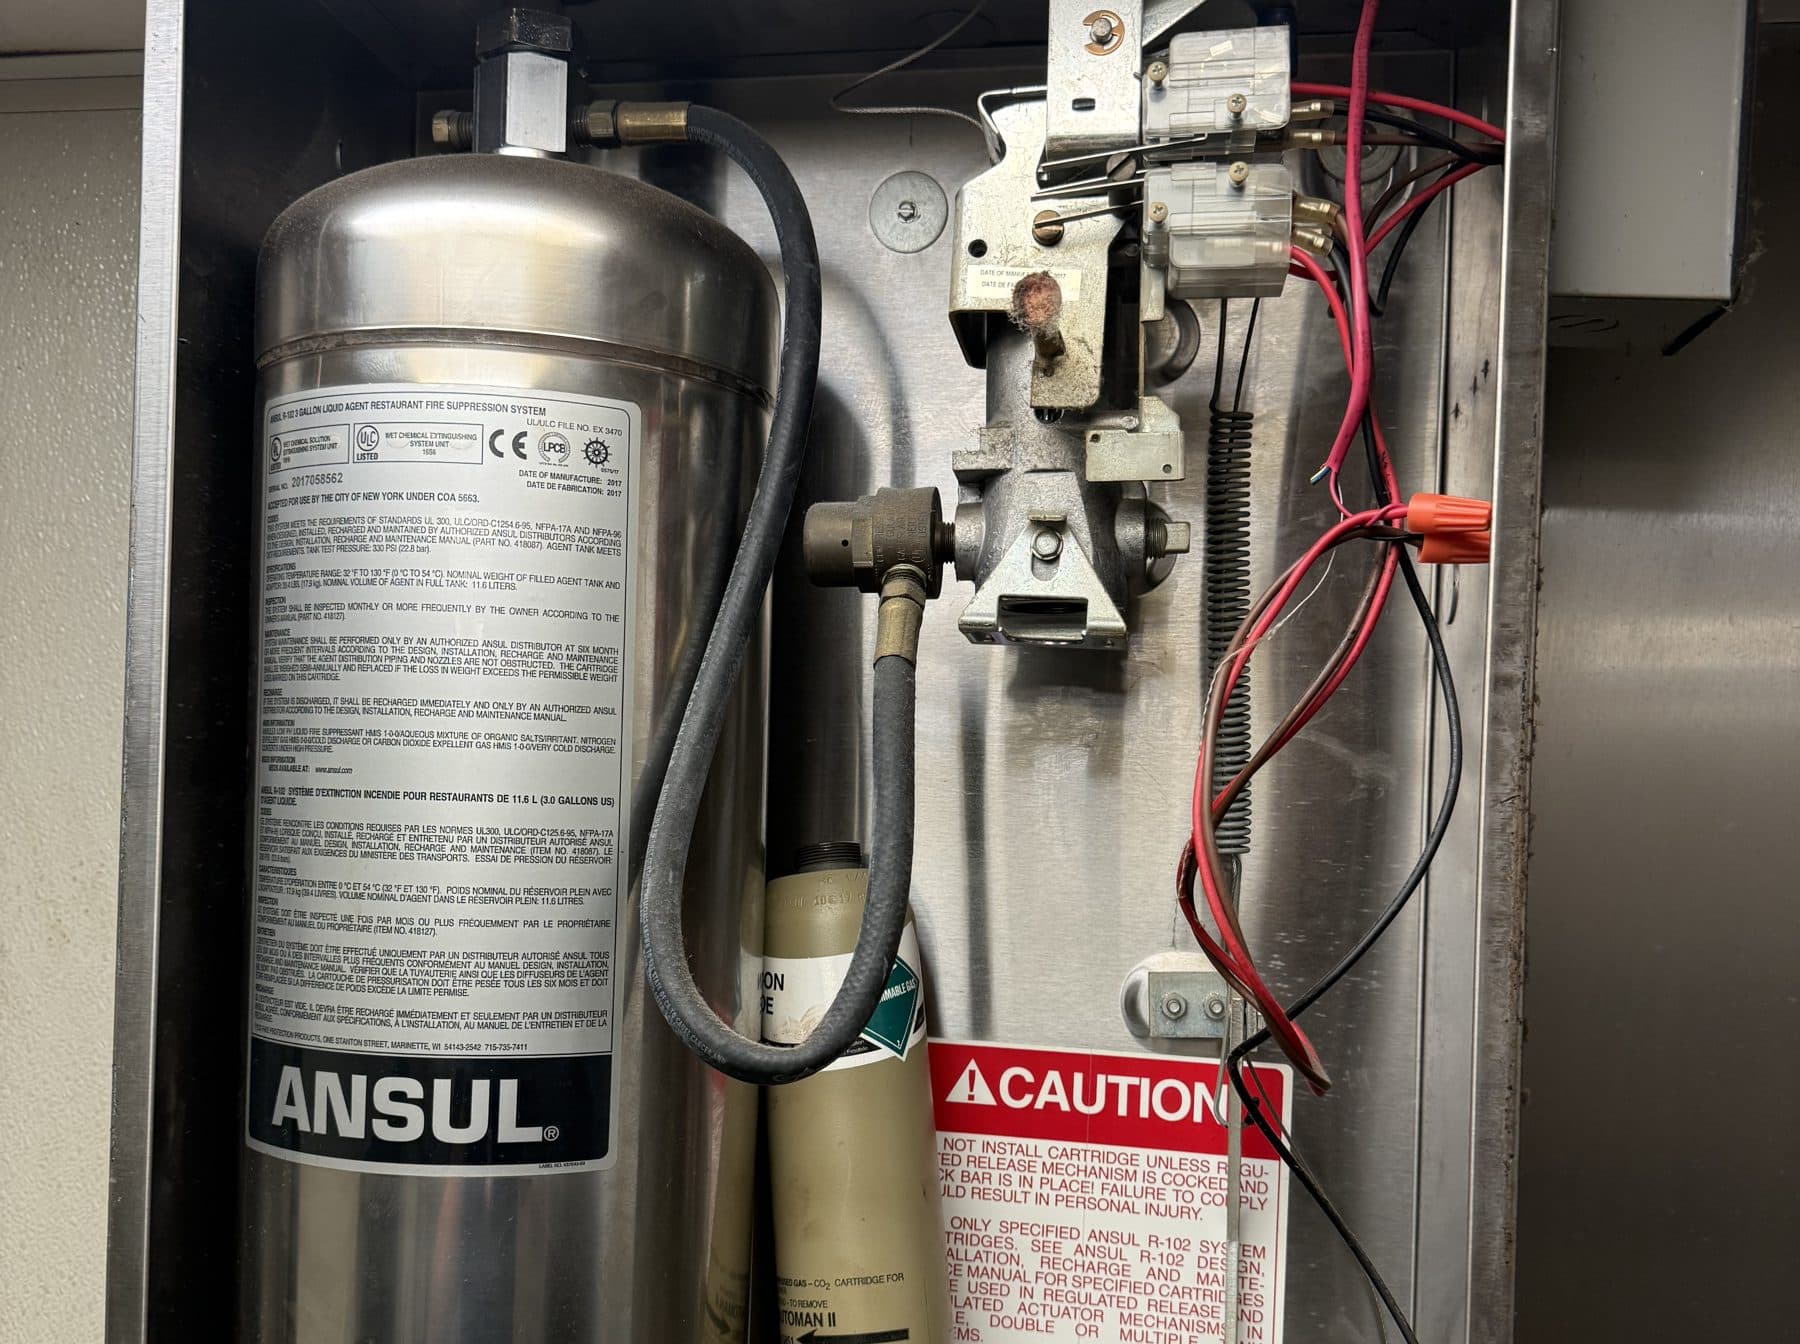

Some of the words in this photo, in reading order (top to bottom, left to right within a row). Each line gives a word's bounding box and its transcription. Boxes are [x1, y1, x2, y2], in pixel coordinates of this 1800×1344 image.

[294, 409, 299, 418] 3
[299, 406, 322, 417] GALLON
[322, 403, 343, 414] LIQUID
[345, 402, 369, 412] AGENT
[370, 401, 423, 411] RESTAURANT
[425, 401, 444, 410] FIRE
[447, 402, 508, 413] SUPPRESSION
[511, 406, 546, 416] SYSTEM
[430, 432, 477, 441] EXTINGUISHING
[527, 418, 555, 428] UL/ULC
[558, 422, 574, 430] FILE
[593, 426, 603, 434] EX
[605, 427, 622, 436] 3470
[292, 472, 343, 488] 2017058562
[519, 469, 538, 478] DATE
[539, 470, 548, 478] OF
[550, 472, 602, 485] MANUFACTURE:
[607, 478, 622, 487] 2017
[289, 497, 299, 506] FOR
[300, 495, 310, 505] USE
[311, 494, 320, 504] BY
[321, 494, 333, 504] THE
[335, 493, 349, 502] CITY
[351, 492, 361, 502] OF
[362, 492, 381, 501] NEW
[382, 492, 404, 501] YORK
[406, 492, 435, 501] UNDER
[436, 492, 456, 502] COA
[458, 493, 480, 503] 5663.
[527, 481, 544, 490] DATE
[547, 482, 557, 490] DE
[558, 483, 604, 495] FABRICATION:
[607, 488, 622, 497] 2017
[447, 570, 482, 579] NOMINAL
[483, 572, 515, 582] WEIGHT
[516, 573, 527, 582] OF
[529, 574, 555, 584] FILLED
[557, 575, 583, 586] AGENT
[584, 578, 604, 588] TANK
[605, 581, 621, 589] AND
[315, 788, 362, 799] D'EXTINCTION
[364, 790, 401, 800] INCENDIE
[403, 791, 427, 801] POUR
[430, 792, 494, 802] RESTAURANTS
[497, 794, 509, 804] DE
[512, 795, 529, 804] 11.6
[532, 795, 537, 804] L
[540, 795, 555, 807] (3.0
[558, 796, 598, 805] GALLONS
[601, 797, 615, 808] US)
[336, 1037, 362, 1047] STANTON
[391, 1041, 430, 1051] MARINETTE,
[444, 1043, 482, 1051] 54143-2542
[484, 1043, 527, 1051] 715-735-7411
[999, 1066, 1228, 1124] CAUTION
[944, 1138, 976, 1153] NOT
[982, 1141, 1042, 1158] INSTALL
[1048, 1146, 1140, 1166] CARTRIDGE
[1146, 1154, 1210, 1173] UNLESS
[1217, 1161, 1269, 1178] RGU-
[967, 1155, 1037, 1173] RELEASE
[1042, 1162, 1137, 1182] MECHANISM
[1142, 1171, 1157, 1184] IS
[1162, 1173, 1228, 1191] COCKED
[961, 1170, 992, 1185] BAR
[998, 1173, 1012, 1187] IS
[1019, 1175, 1033, 1189] IN
[1040, 1177, 1095, 1194] PLACE!
[1101, 1182, 1166, 1201] FAILURE
[1172, 1188, 1194, 1204] TO
[1200, 1192, 1268, 1211] COPLY
[971, 1187, 1030, 1204] RESULT
[1035, 1192, 1049, 1206] IN
[1055, 1194, 1140, 1215] PERSONAL
[1144, 1205, 1203, 1221] INJURY.
[950, 1216, 991, 1232] ONLY
[1000, 1221, 1080, 1240] SPECIFIED
[1088, 1229, 1140, 1246] ANSUL
[1148, 1234, 1191, 1251] R-102
[1200, 1240, 1266, 1259] SYSEM
[1031, 1240, 1063, 1255] SEE
[1074, 1244, 1127, 1262] ANSUL
[1140, 1250, 1184, 1266] R-102
[1197, 1256, 1265, 1276] DESGN,
[834, 1275, 884, 1287] CARTRIDGE
[886, 1273, 904, 1283] FOR
[967, 1265, 1031, 1284] MANUAL
[1035, 1272, 1067, 1287] FOR
[1072, 1275, 1154, 1296] SPECIFIED
[1040, 1256, 1131, 1278] RECHARGE
[1146, 1267, 1181, 1282] AND
[1196, 1272, 1265, 1291] MAITE-
[798, 1300, 828, 1308] REMOVE
[968, 1281, 1010, 1297] USED
[1019, 1286, 1034, 1299] IN
[1043, 1288, 1138, 1310] REGULATED
[1148, 1299, 1221, 1319] RELEASE
[828, 1312, 836, 1327] II
[990, 1314, 1055, 1333] DOUBLE
[1075, 1323, 1099, 1338] OR
[1120, 1328, 1198, 1344] MULTIPLE
[1017, 1302, 1104, 1323] ACTUATOR
[1247, 1326, 1263, 1340] IN
